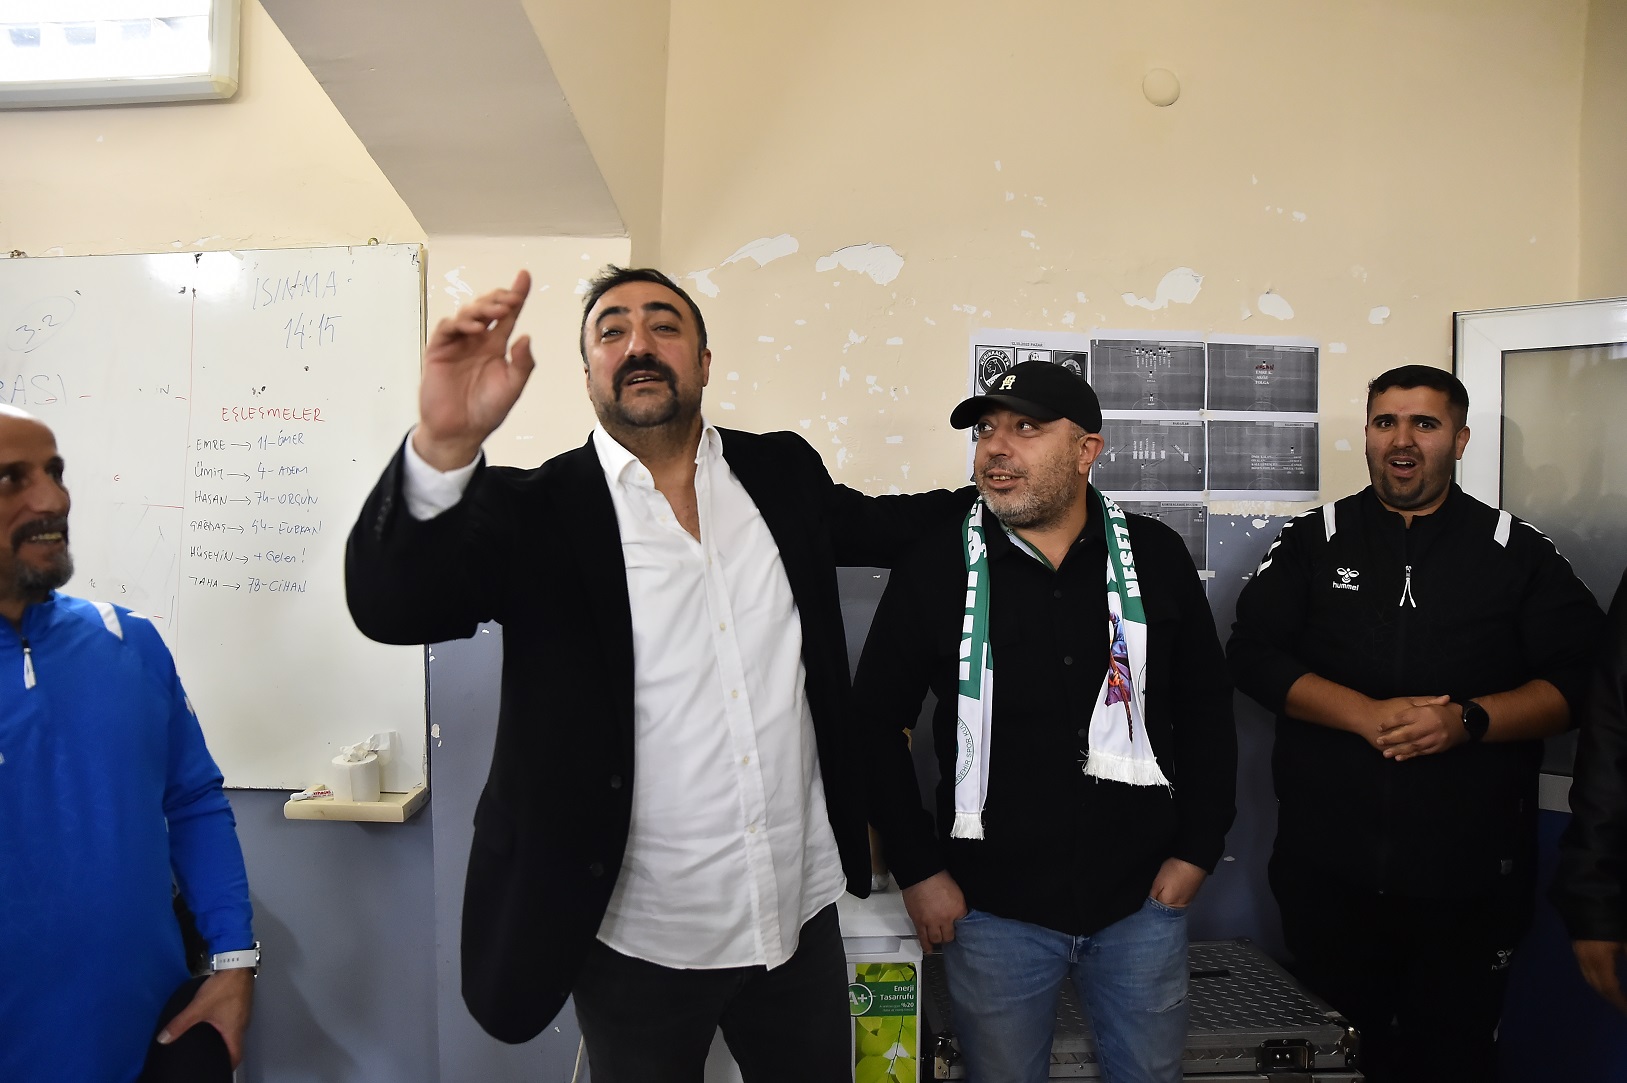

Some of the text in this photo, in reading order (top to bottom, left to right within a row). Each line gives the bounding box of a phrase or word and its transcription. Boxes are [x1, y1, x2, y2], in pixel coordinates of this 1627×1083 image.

[252, 270, 337, 311] ISINMA
[283, 312, 343, 350] 14:15
[196, 438, 226, 451] EMRE
[194, 490, 228, 506] HASAN
[188, 576, 218, 587] TAHA
[1332, 580, 1360, 592] hummel
[879, 992, 915, 1001] Tasarrufu
